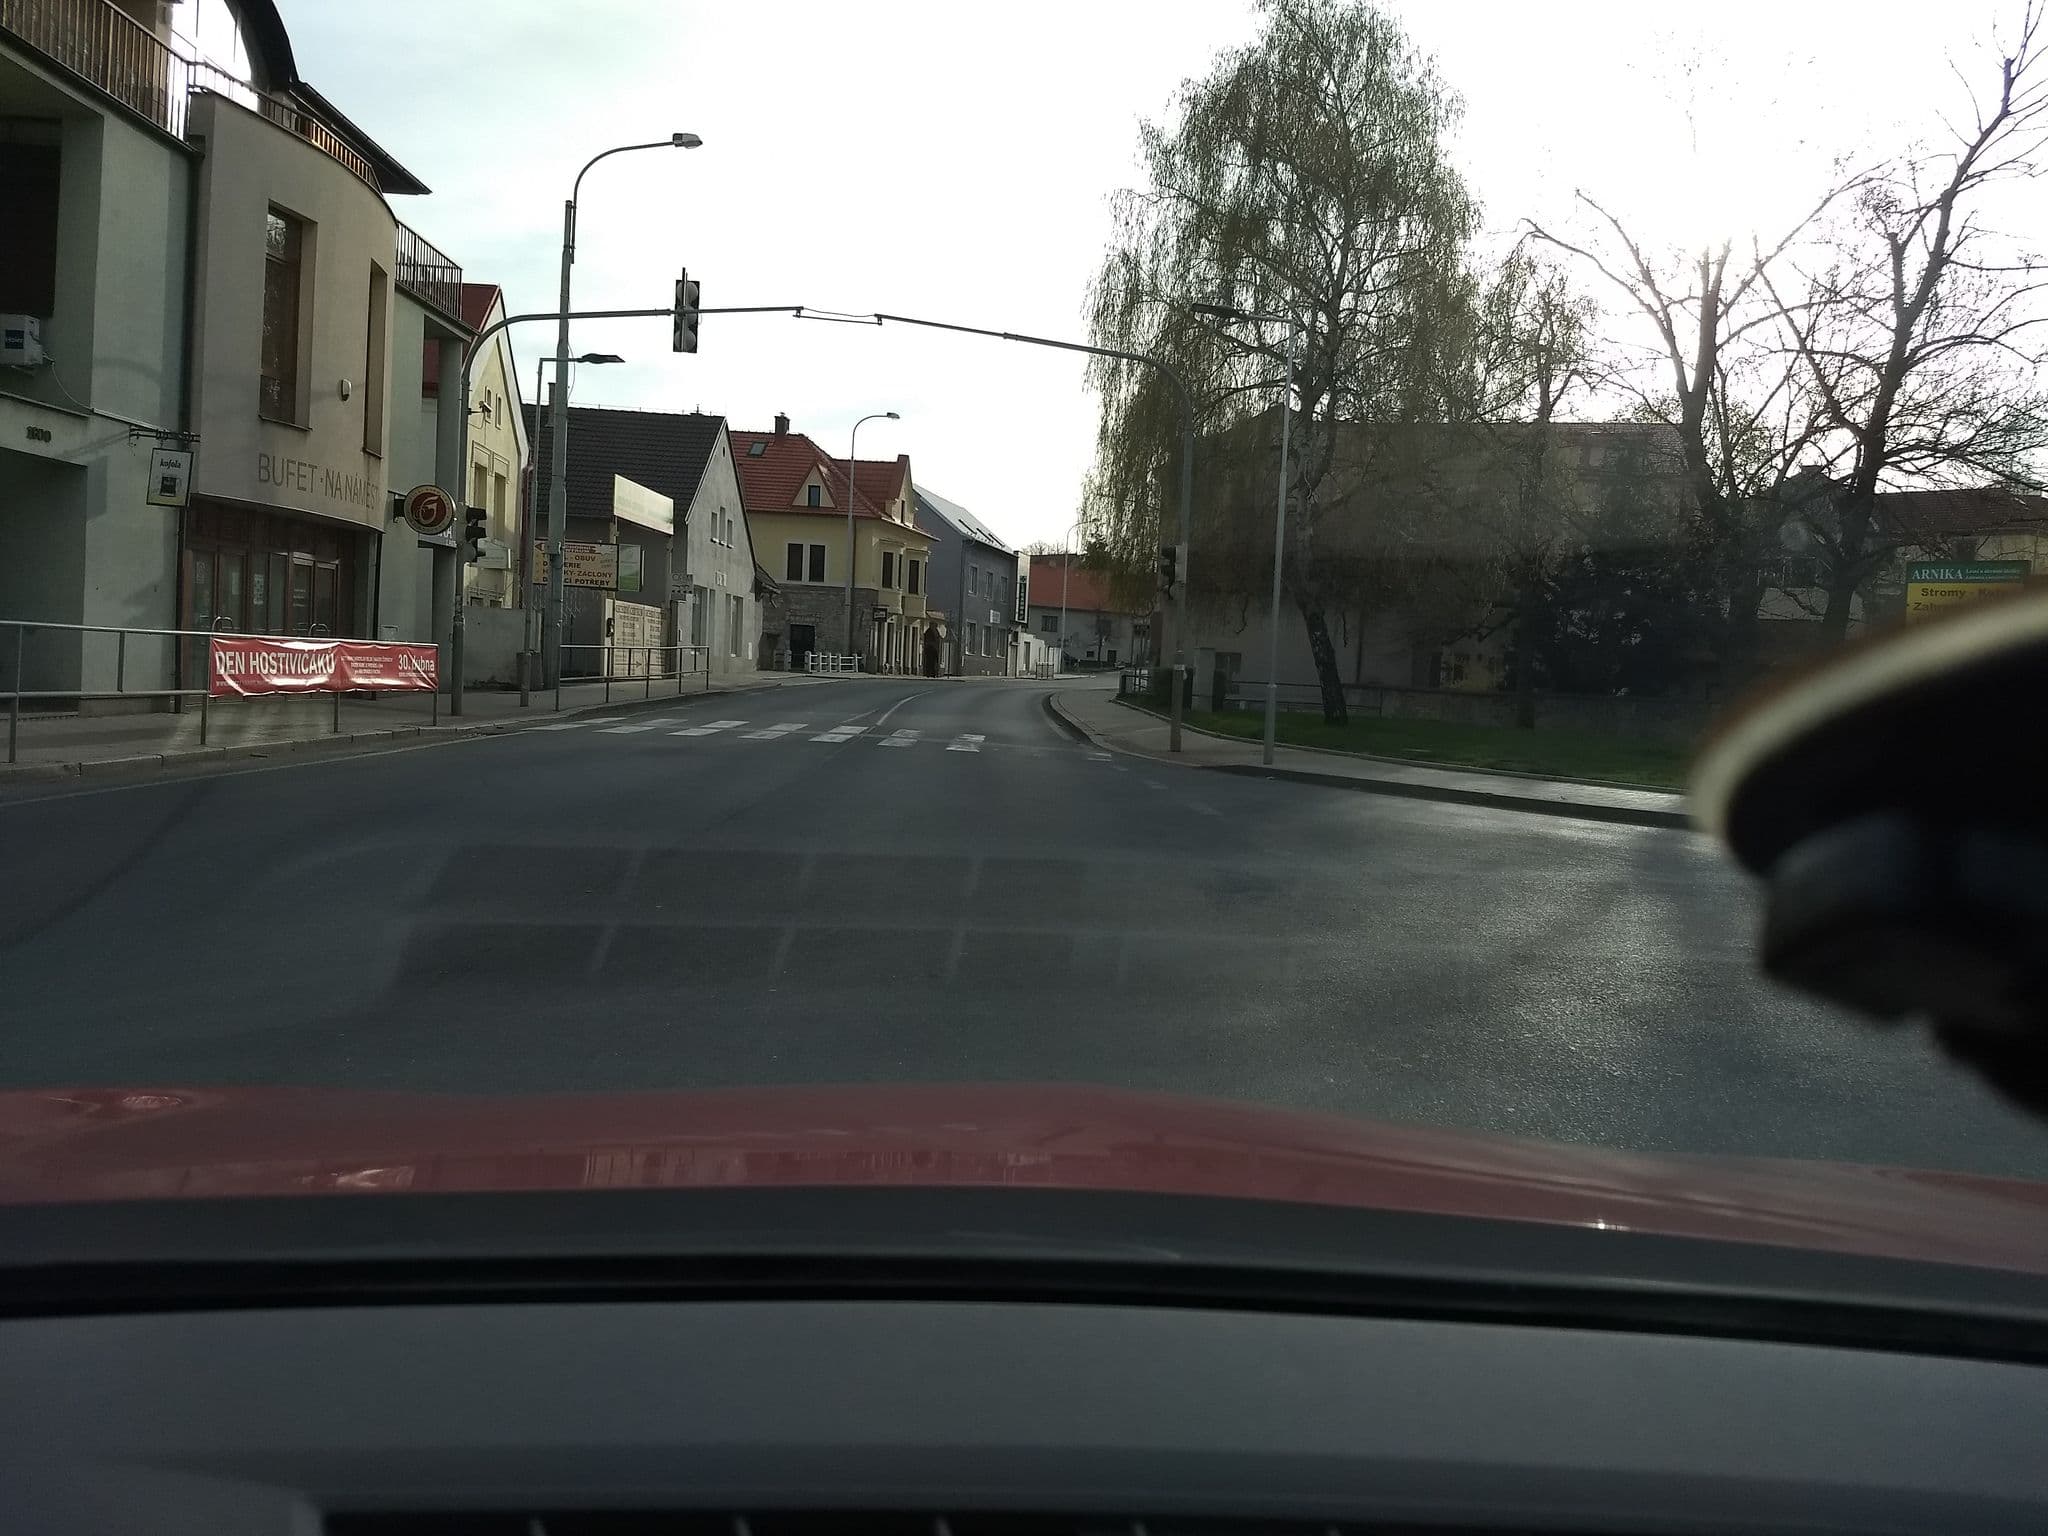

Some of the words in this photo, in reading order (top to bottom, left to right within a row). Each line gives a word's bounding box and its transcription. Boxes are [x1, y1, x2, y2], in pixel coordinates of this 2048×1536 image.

[258, 453, 318, 493] BUFET
[324, 468, 343, 500] NA
[1912, 568, 1963, 580] ARNIKA
[1921, 588, 1966, 602] Stromy
[215, 651, 245, 674] DEN
[398, 654, 411, 670] 30.
[411, 655, 435, 672] dubna
